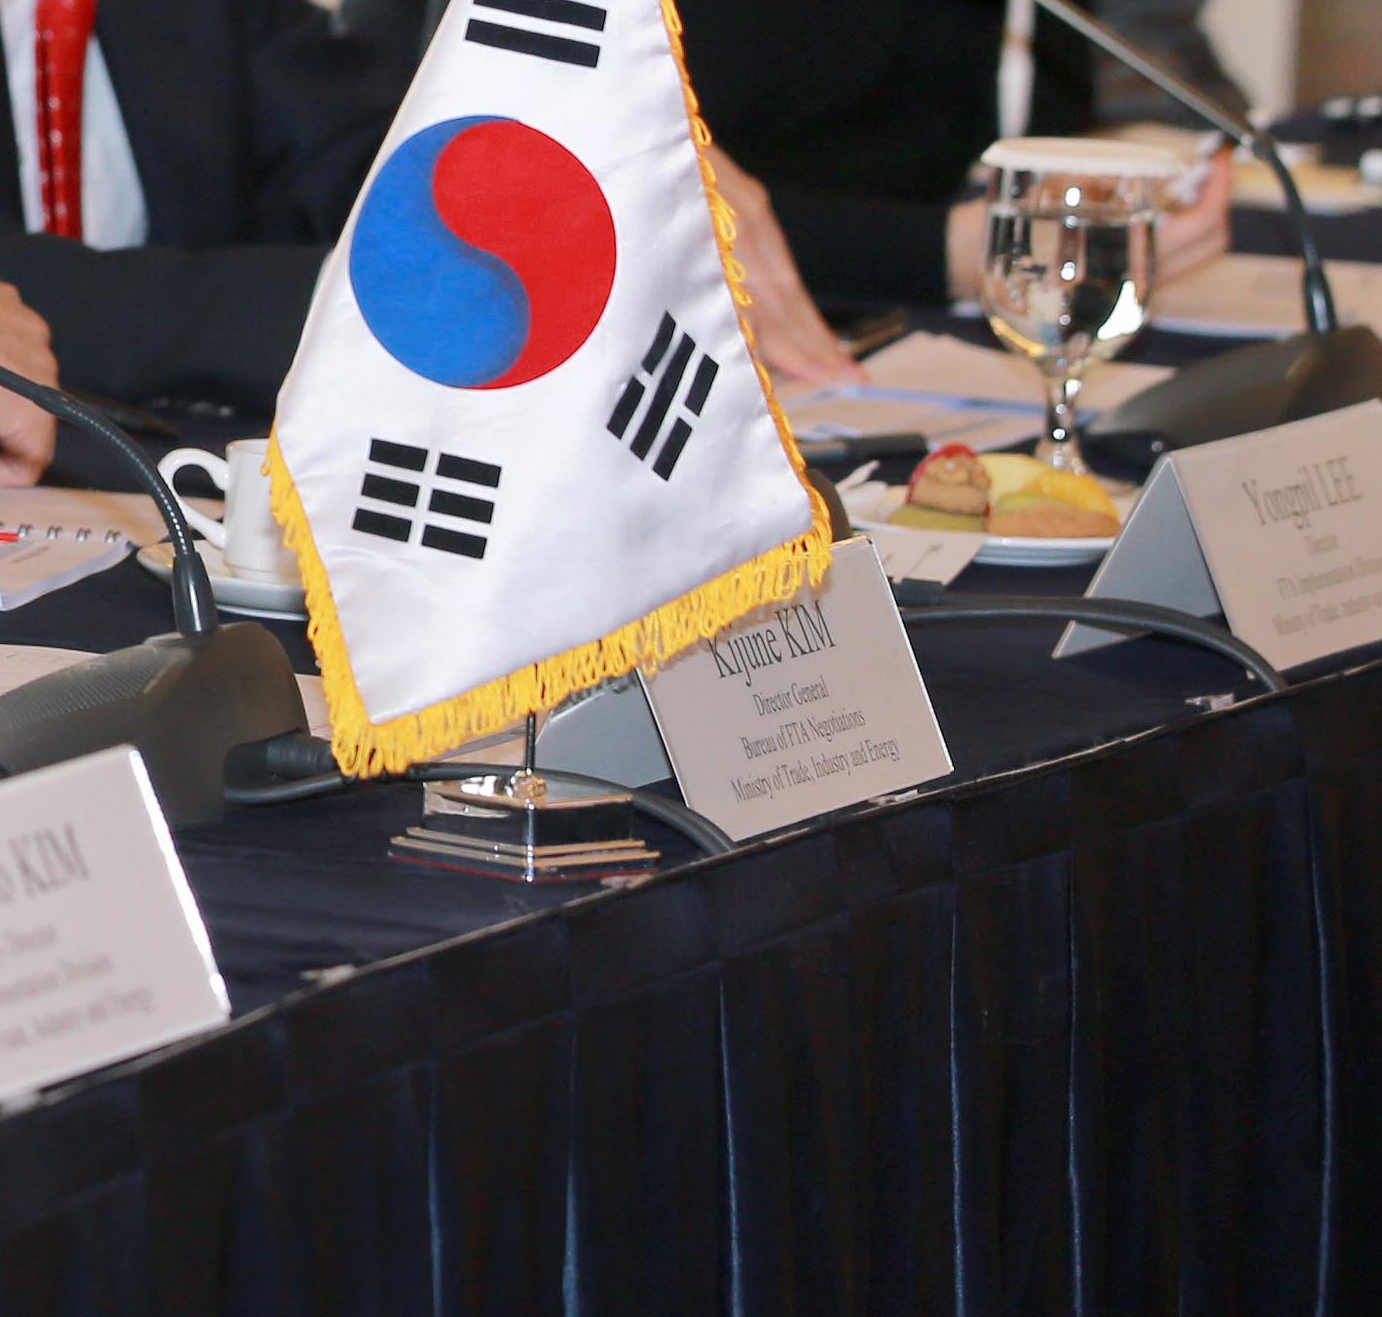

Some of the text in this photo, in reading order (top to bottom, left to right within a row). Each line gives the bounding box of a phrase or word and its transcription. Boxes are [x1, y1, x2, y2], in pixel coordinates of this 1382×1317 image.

[1315, 456, 1363, 509] LEE
[708, 599, 836, 687] Kijune KIM
[753, 675, 830, 717] Director General
[741, 733, 777, 760] Bureau
[785, 720, 811, 748] FTA
[810, 708, 866, 742] Negotiations
[730, 776, 772, 804] Ministry
[810, 752, 852, 781] Industry
[849, 746, 869, 769] and
[866, 737, 900, 763] Energy
[8, 823, 90, 897] KIM
